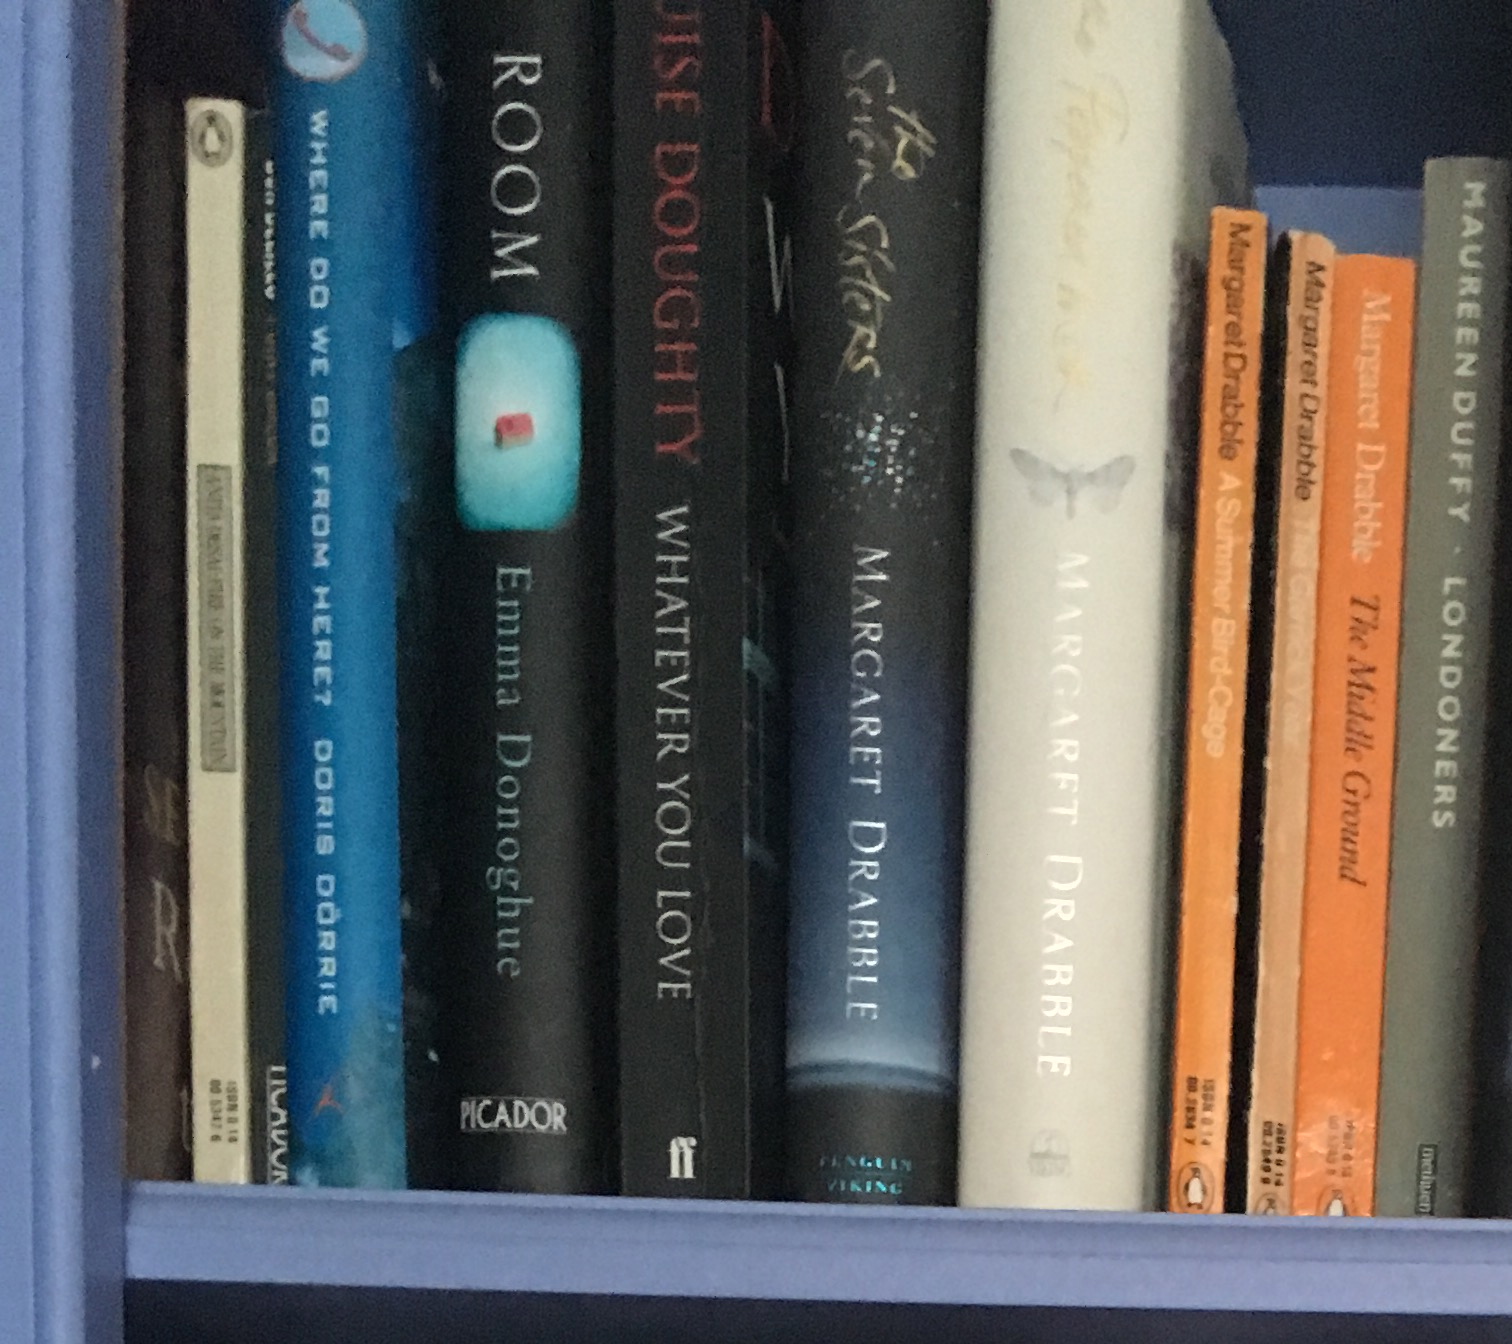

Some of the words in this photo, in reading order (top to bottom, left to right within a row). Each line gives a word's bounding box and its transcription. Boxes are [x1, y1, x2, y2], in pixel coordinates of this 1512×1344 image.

[307, 109, 330, 240] WHERE
[490, 54, 544, 281] ROOM
[307, 258, 331, 310] DO
[1452, 181, 1487, 379] MAUREEN
[307, 325, 332, 378] WE
[1354, 288, 1393, 431] Margaret
[308, 395, 332, 448] GO
[1446, 390, 1475, 525] DUFFY
[308, 465, 332, 569] FROM
[1350, 441, 1388, 565] Drabble
[309, 585, 334, 706] HERE?
[494, 566, 533, 706] Emma
[653, 503, 693, 760] WHATEVER
[1347, 594, 1381, 650] The
[1342, 662, 1379, 757] Middle
[1430, 576, 1468, 828] LONDONERS
[312, 739, 335, 855] DORIS
[485, 733, 534, 979] Donoghue
[654, 773, 693, 869] YOU
[1338, 770, 1373, 886] Ground
[315, 873, 340, 1015] DÖRRIE
[654, 890, 693, 1000] LOVE
[460, 1099, 569, 1131] PICADOR
